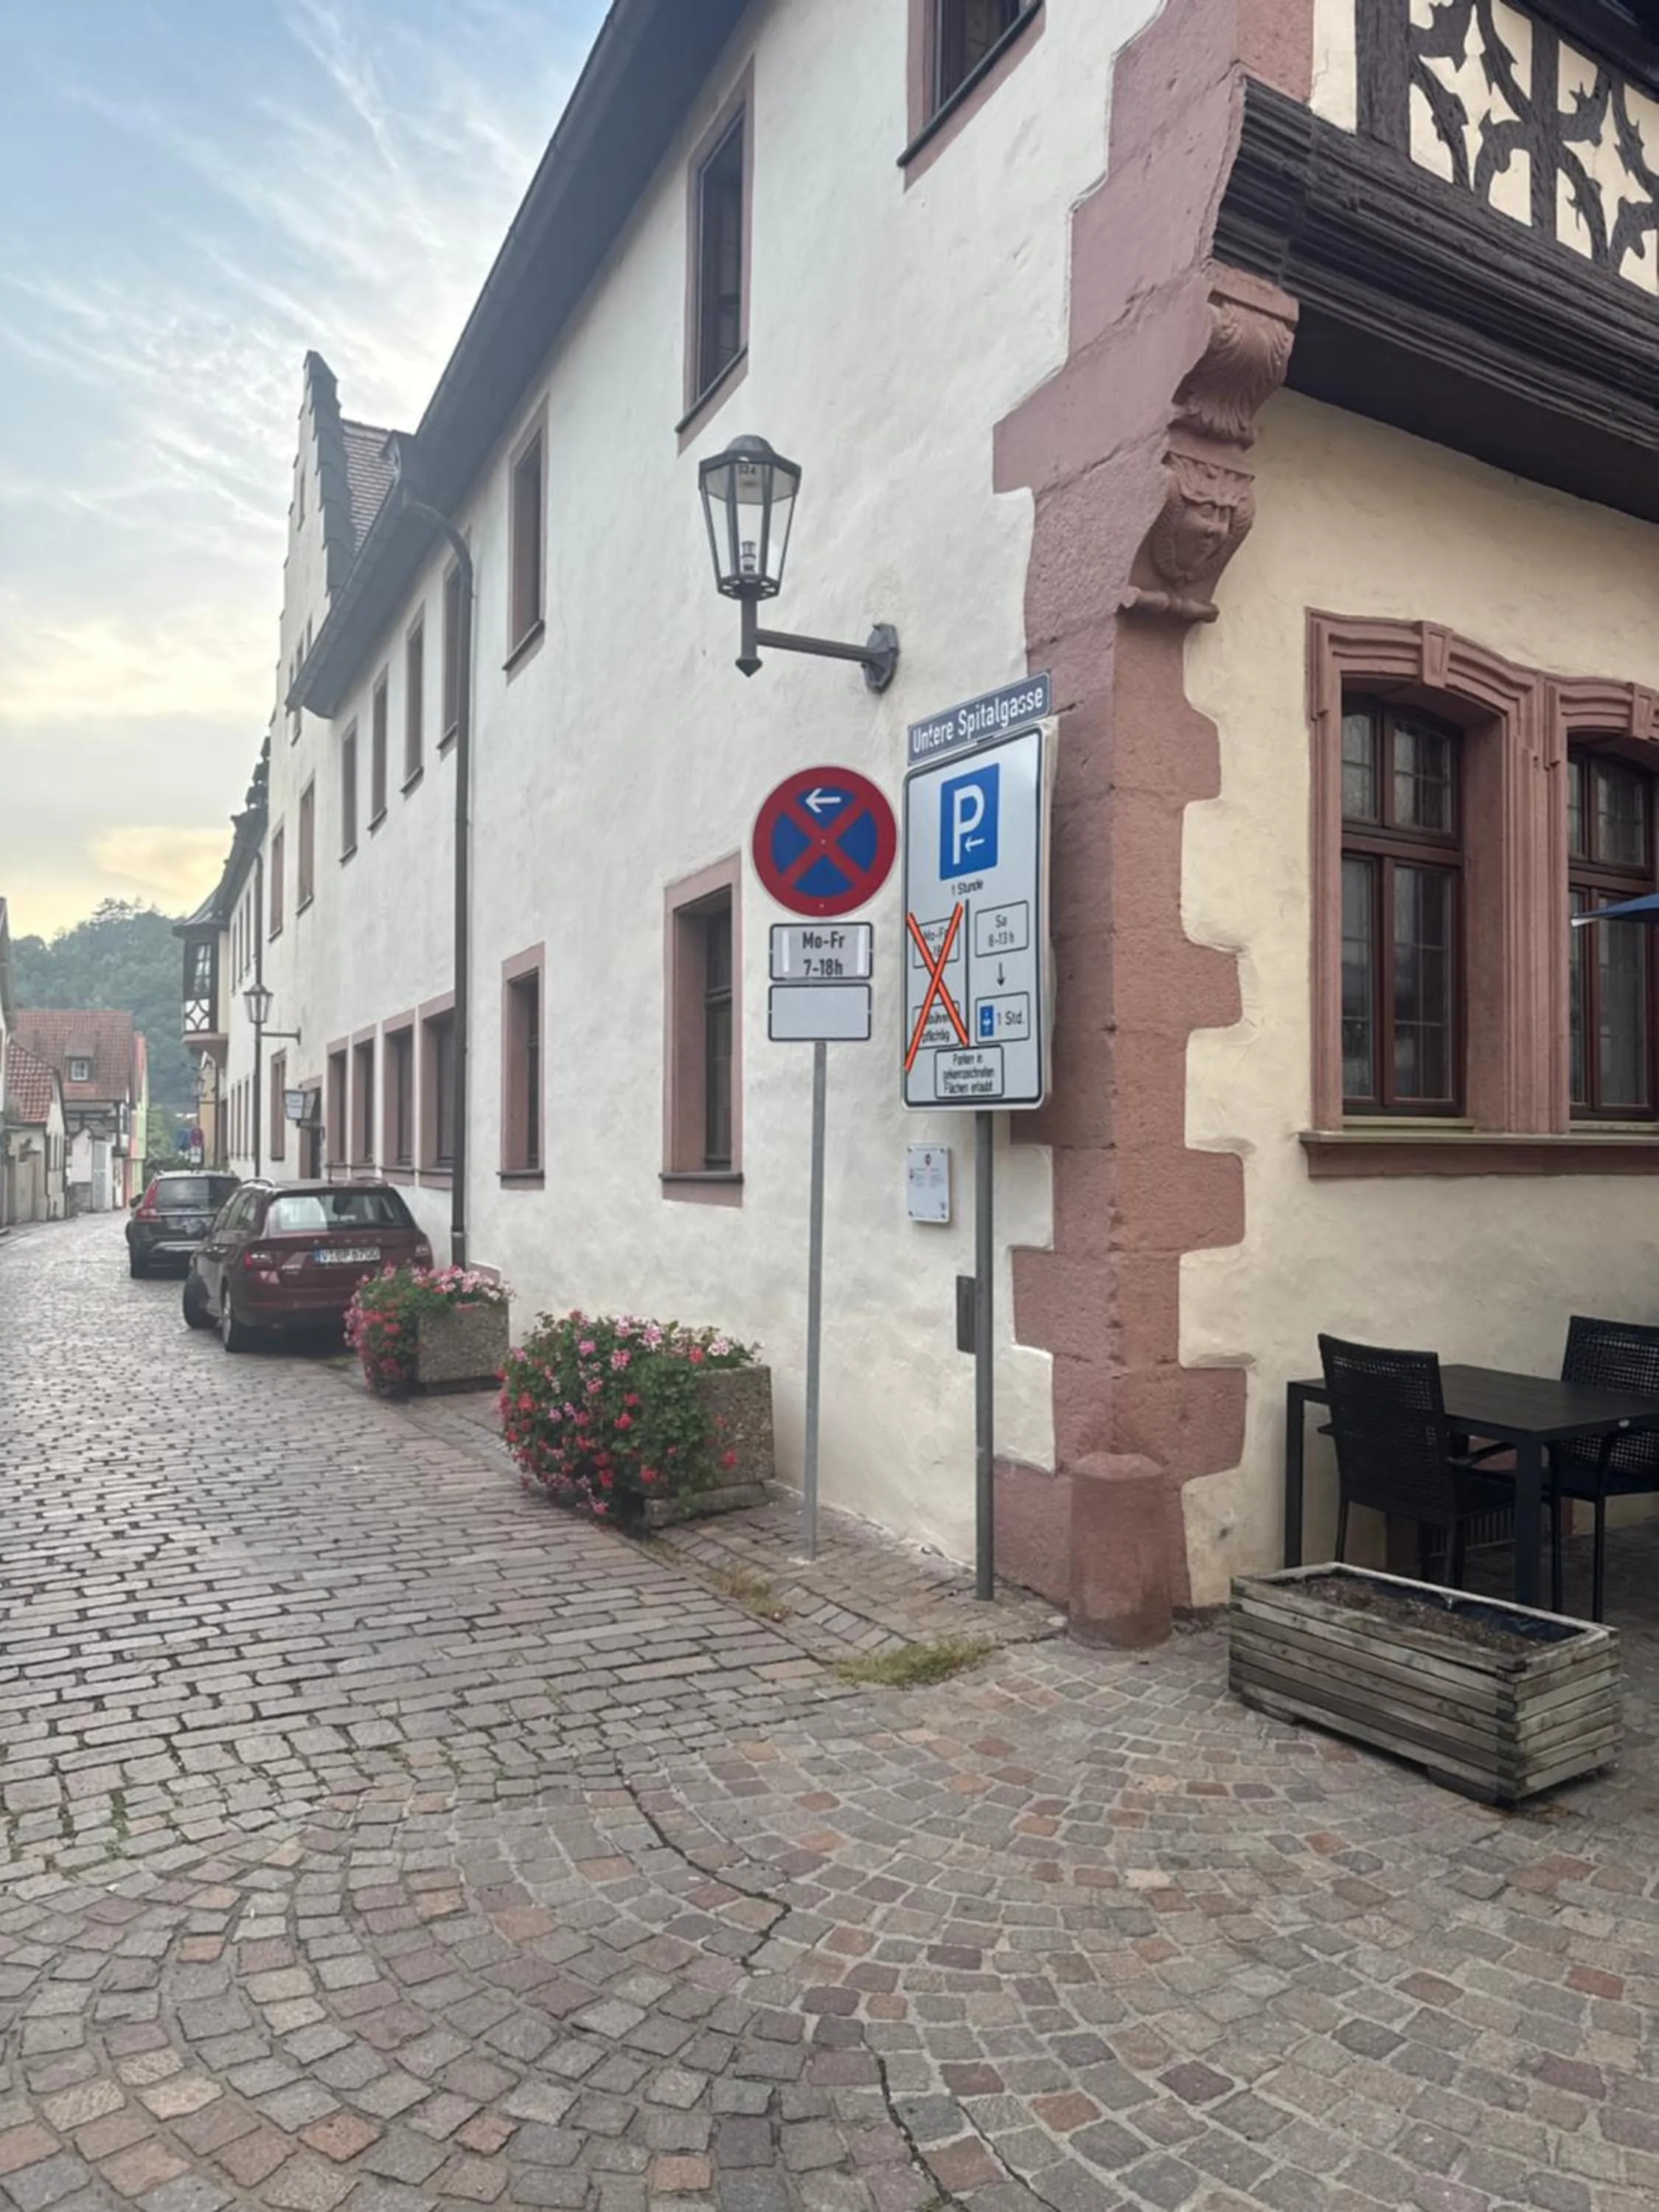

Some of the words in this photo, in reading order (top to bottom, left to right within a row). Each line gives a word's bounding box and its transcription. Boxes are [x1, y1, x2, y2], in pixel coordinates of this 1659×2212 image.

[913, 721, 954, 753] Untere
[959, 687, 1043, 739] Spitalgasse
[953, 784, 985, 865] P
[957, 878, 984, 895] Stunde
[802, 931, 845, 949] Mo-Fr
[803, 959, 844, 976] 7-18h
